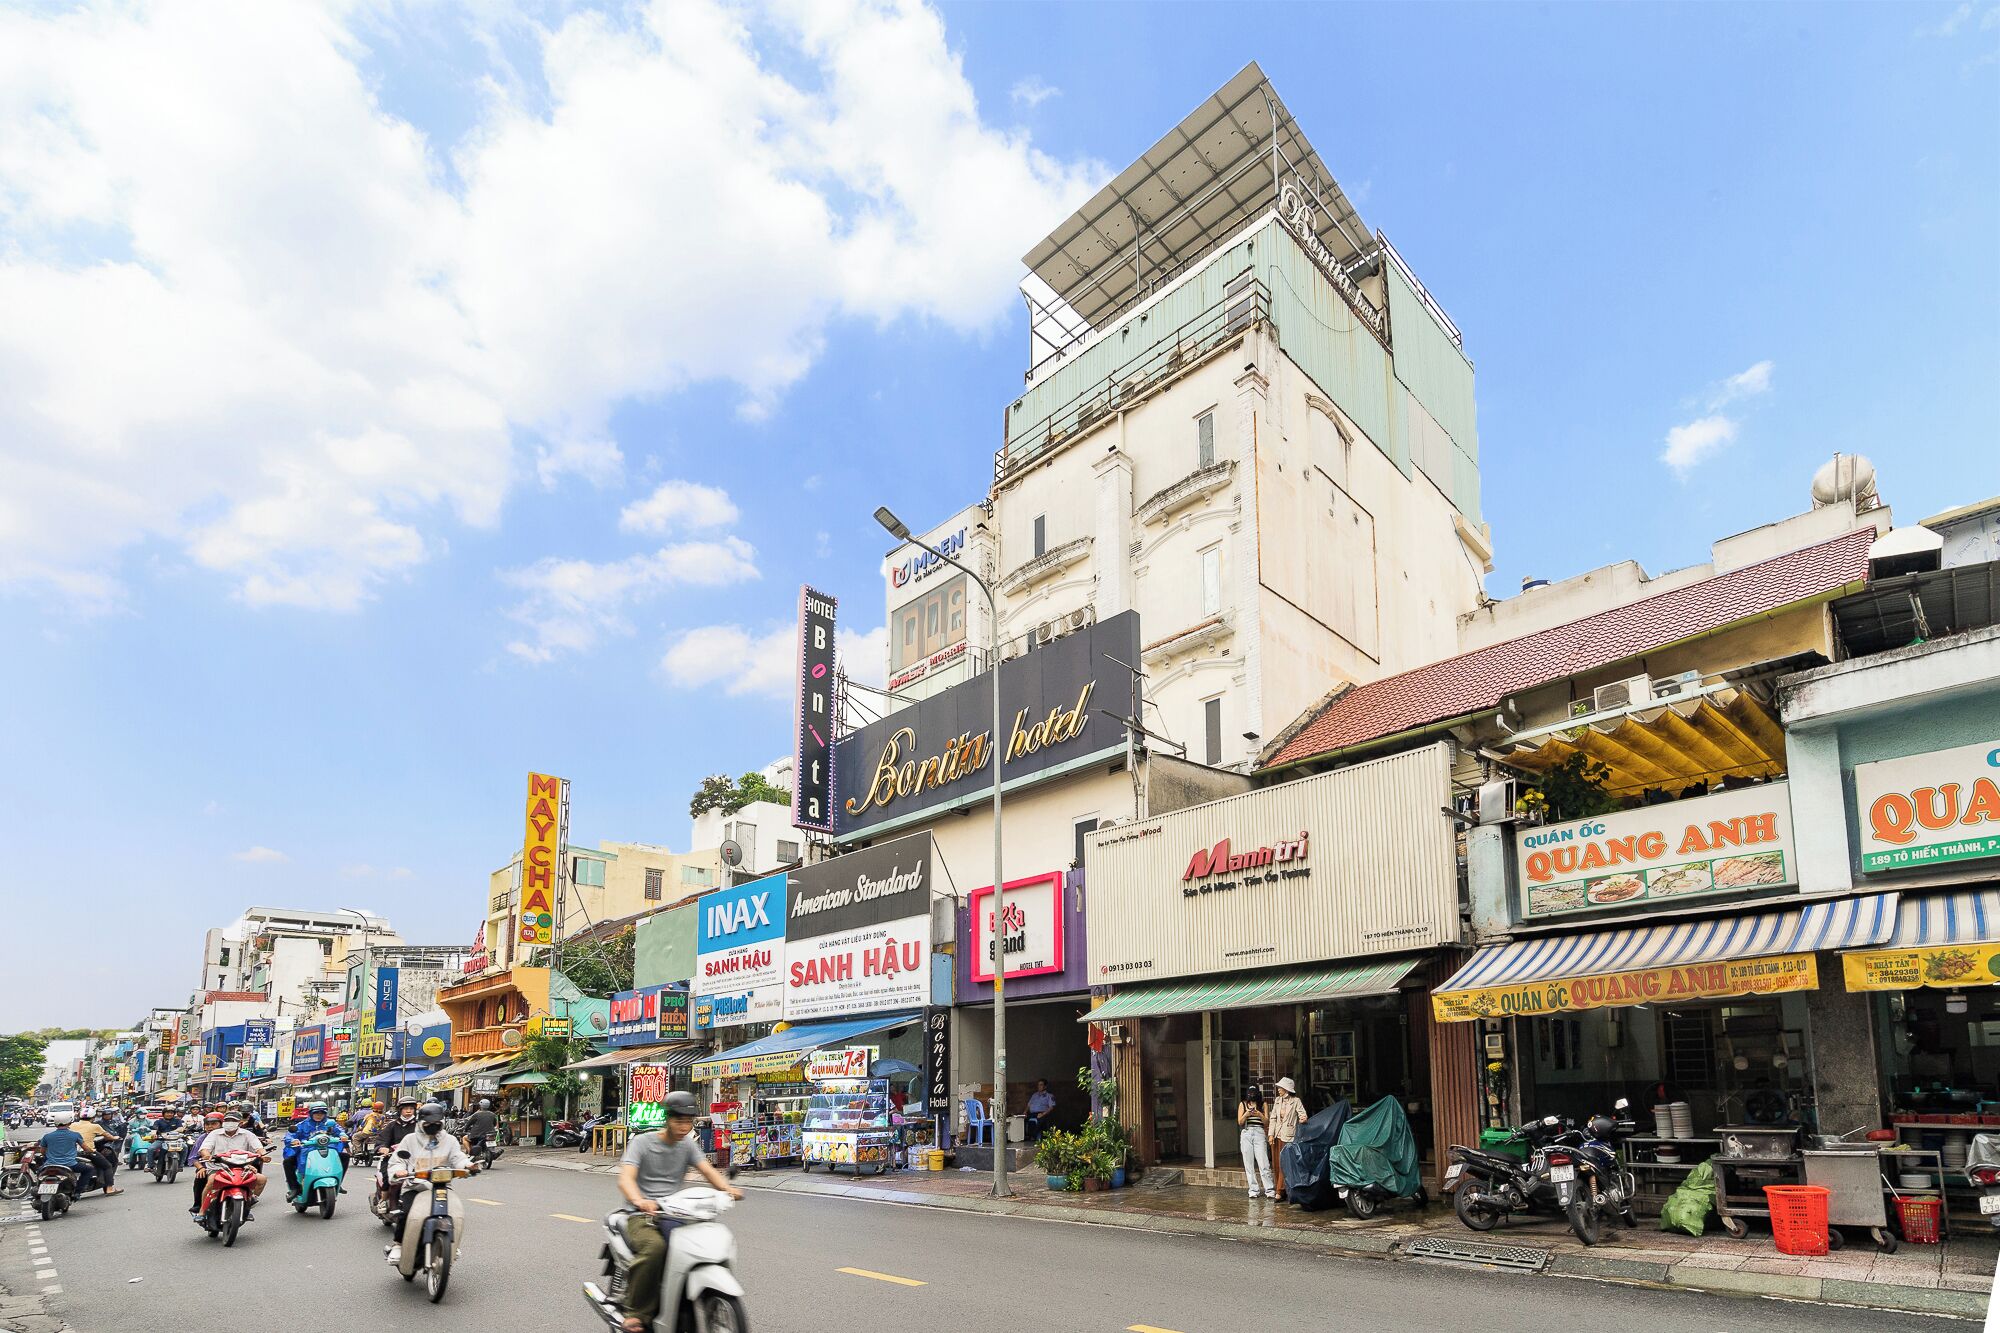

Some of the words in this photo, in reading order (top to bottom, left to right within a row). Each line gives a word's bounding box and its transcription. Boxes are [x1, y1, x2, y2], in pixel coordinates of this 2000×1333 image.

[914, 529, 964, 574] MOEN
[806, 597, 835, 620] HOTEL
[846, 726, 993, 816] Bonita
[1005, 679, 1096, 764] hotel
[524, 774, 557, 912] MAYCHA
[1524, 828, 1573, 848] QUÁN
[1579, 820, 1606, 838] ỐC
[1526, 830, 1668, 882] QUANG
[1676, 812, 1780, 855] ANH
[1870, 854, 1891, 866] 189
[1893, 850, 1908, 862] TÔ
[1912, 846, 1939, 860] HIẾN
[1941, 841, 1985, 856] THÀNH,
[791, 888, 853, 918] American
[854, 860, 923, 903] Standard
[708, 892, 770, 938] INAX
[990, 931, 1025, 960] gand
[1224, 946, 1276, 958] www.manhtri.com
[706, 956, 740, 976] SANH
[742, 950, 772, 972] HẬU
[790, 952, 853, 988] SANH
[864, 938, 921, 981] HẬU
[1108, 964, 1124, 972] 0913
[1126, 962, 1134, 970] 03
[1135, 962, 1143, 970] 03
[1144, 960, 1152, 968] 03
[1874, 959, 1894, 969] NHẬT
[1895, 958, 1910, 968] TÂN
[383, 980, 392, 1001] NCB
[664, 993, 686, 1007] PHỞ
[1501, 986, 1542, 1013] QUÁN
[1547, 982, 1568, 1008] ỐC
[1571, 972, 1662, 1008] QUANG
[1667, 964, 1728, 994] ANH
[716, 1014, 729, 1023] Smart
[730, 1013, 748, 1022] Security
[844, 1051, 854, 1076] 7
[930, 1014, 948, 1094] Bonita
[930, 1097, 948, 1107] Hotel
